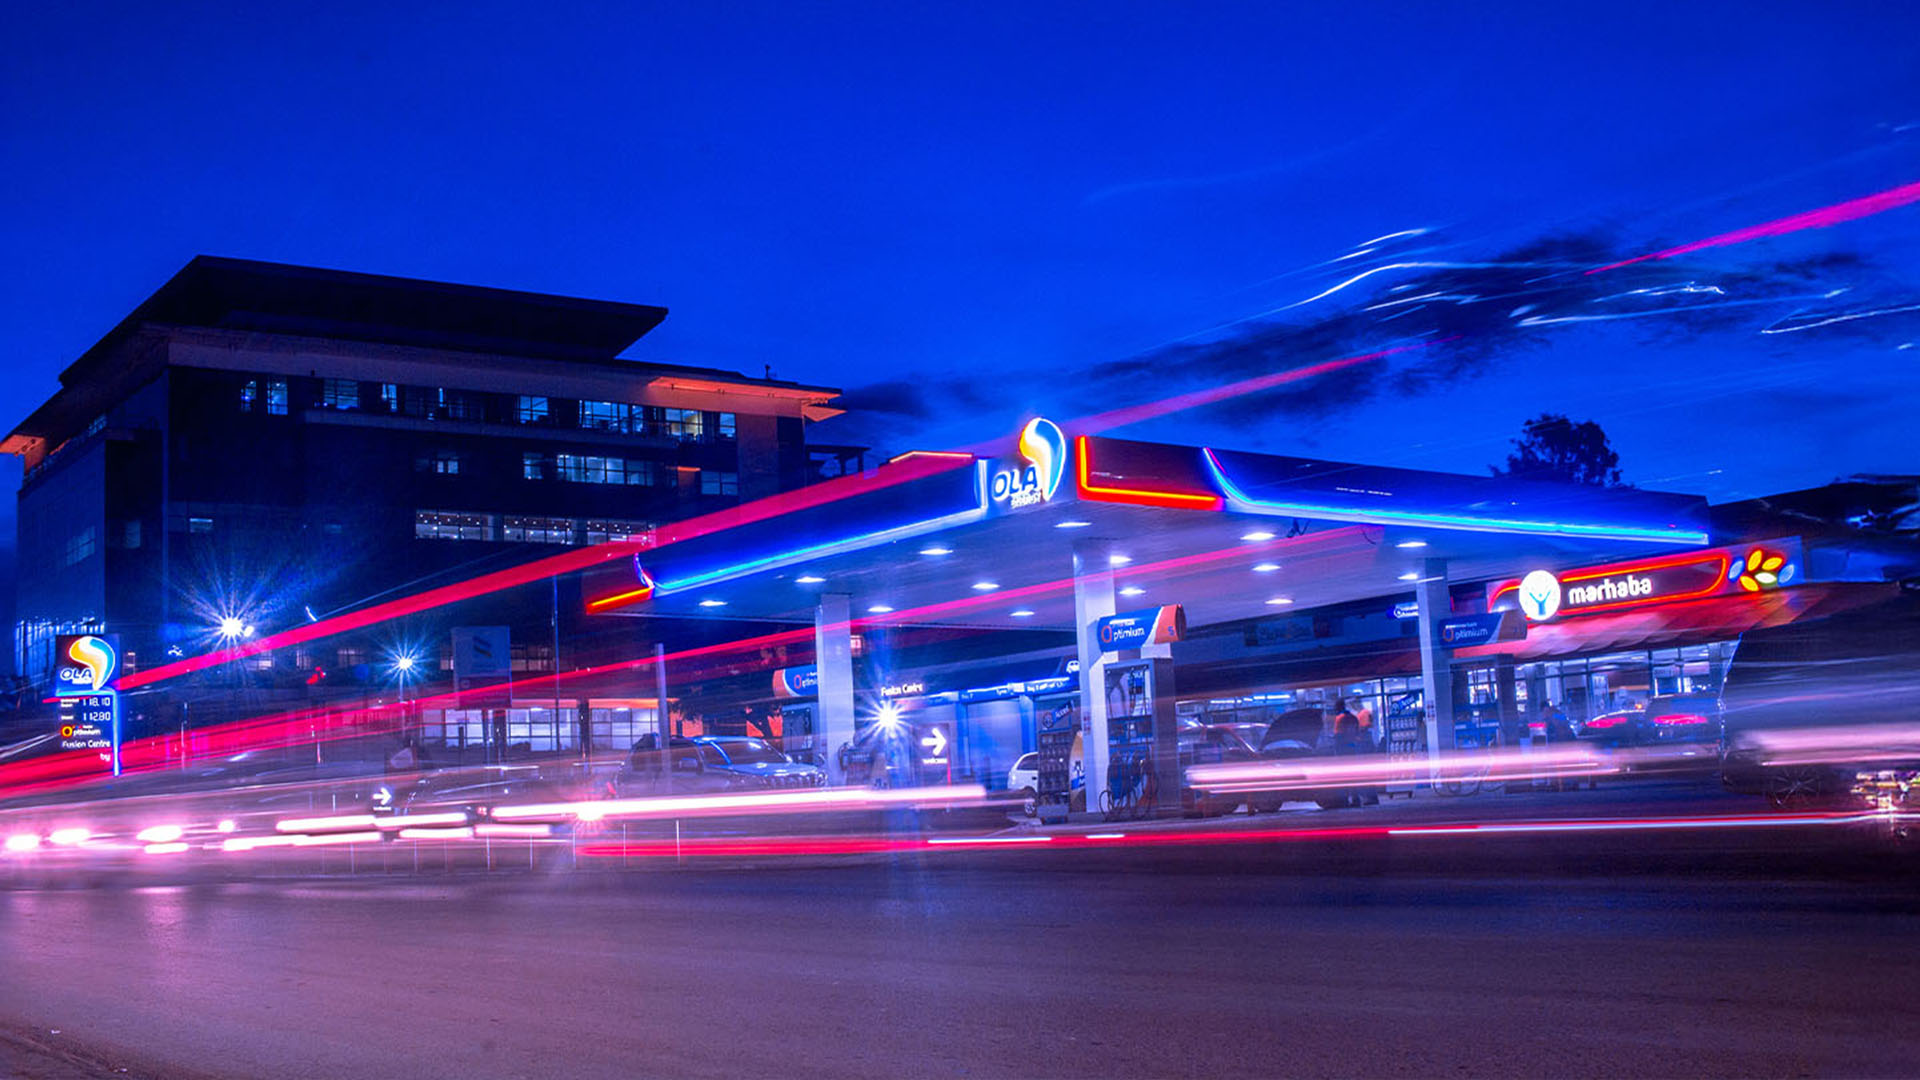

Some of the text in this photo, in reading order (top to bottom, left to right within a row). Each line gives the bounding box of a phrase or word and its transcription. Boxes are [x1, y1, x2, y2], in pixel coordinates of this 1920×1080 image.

[992, 464, 1038, 499] OLA
[1568, 575, 1652, 605] marhaba
[60, 667, 92, 681] OLA
